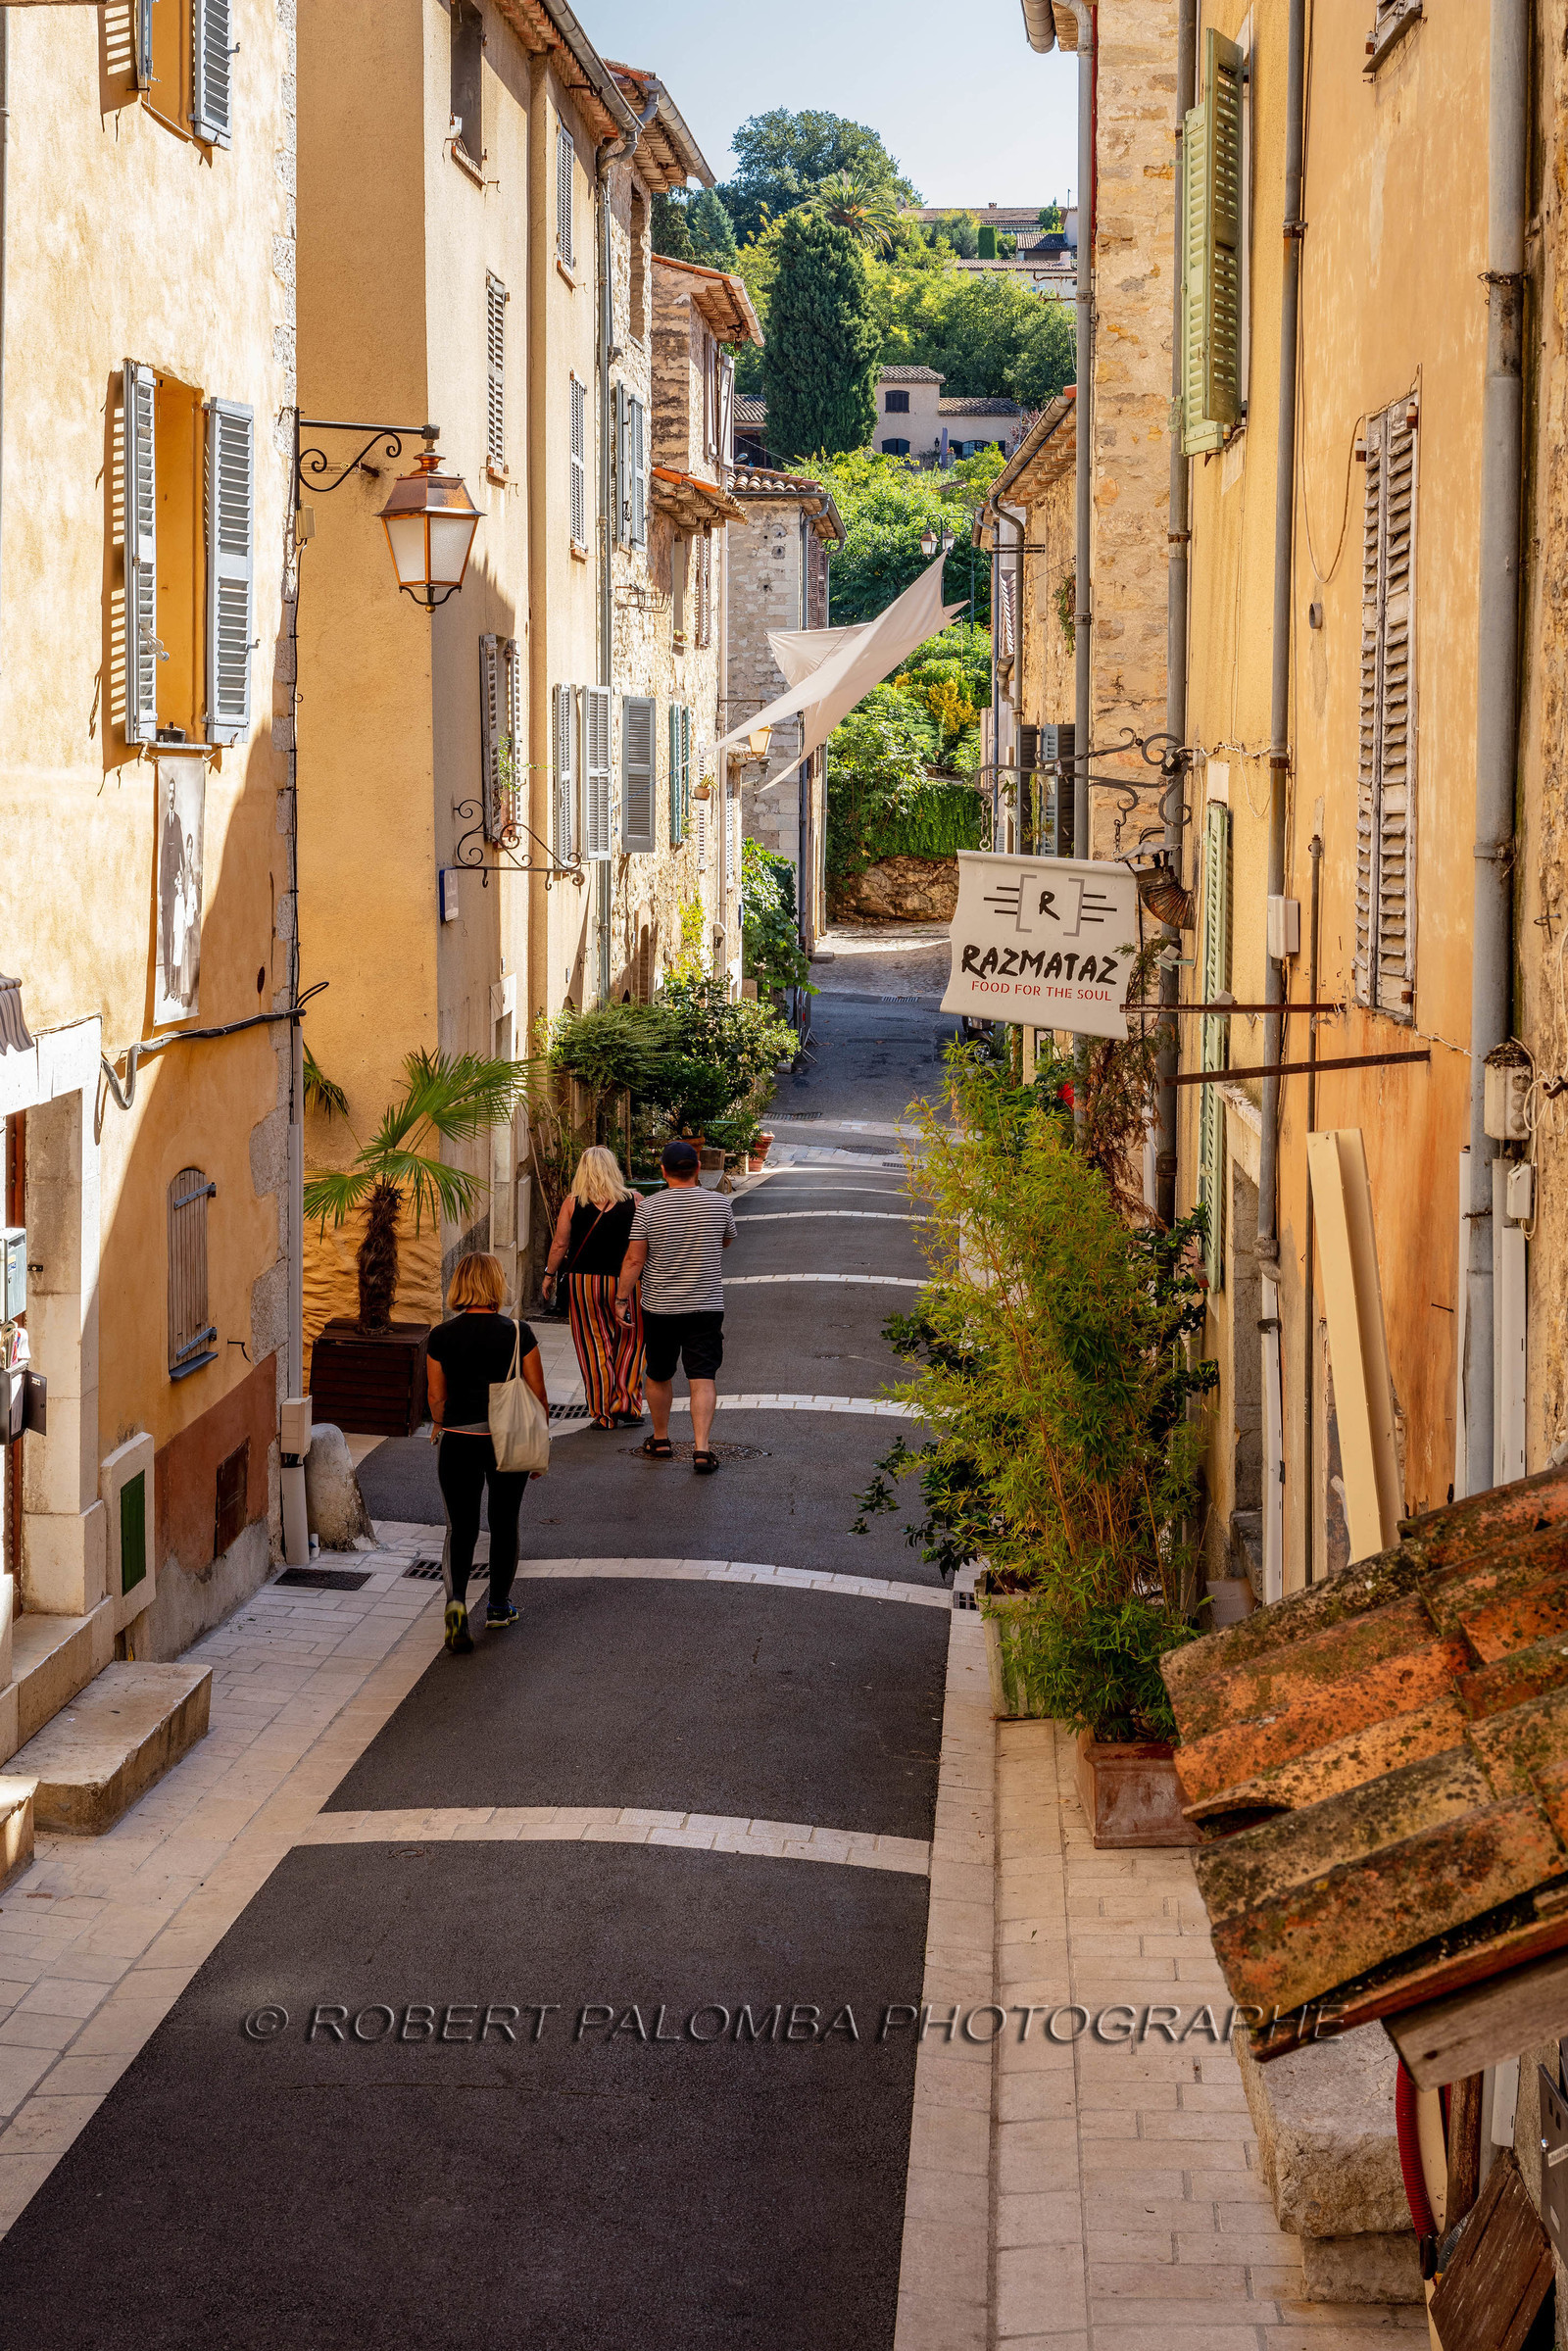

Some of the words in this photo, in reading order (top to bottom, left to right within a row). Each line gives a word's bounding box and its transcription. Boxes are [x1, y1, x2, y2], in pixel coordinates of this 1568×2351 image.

[1038, 890, 1060, 921] R
[961, 944, 1119, 986] RAZMATAZ
[971, 980, 1010, 994] FOOD
[1014, 984, 1041, 997] FOR
[1046, 986, 1072, 999] THE
[1077, 989, 1112, 1002] SOUL
